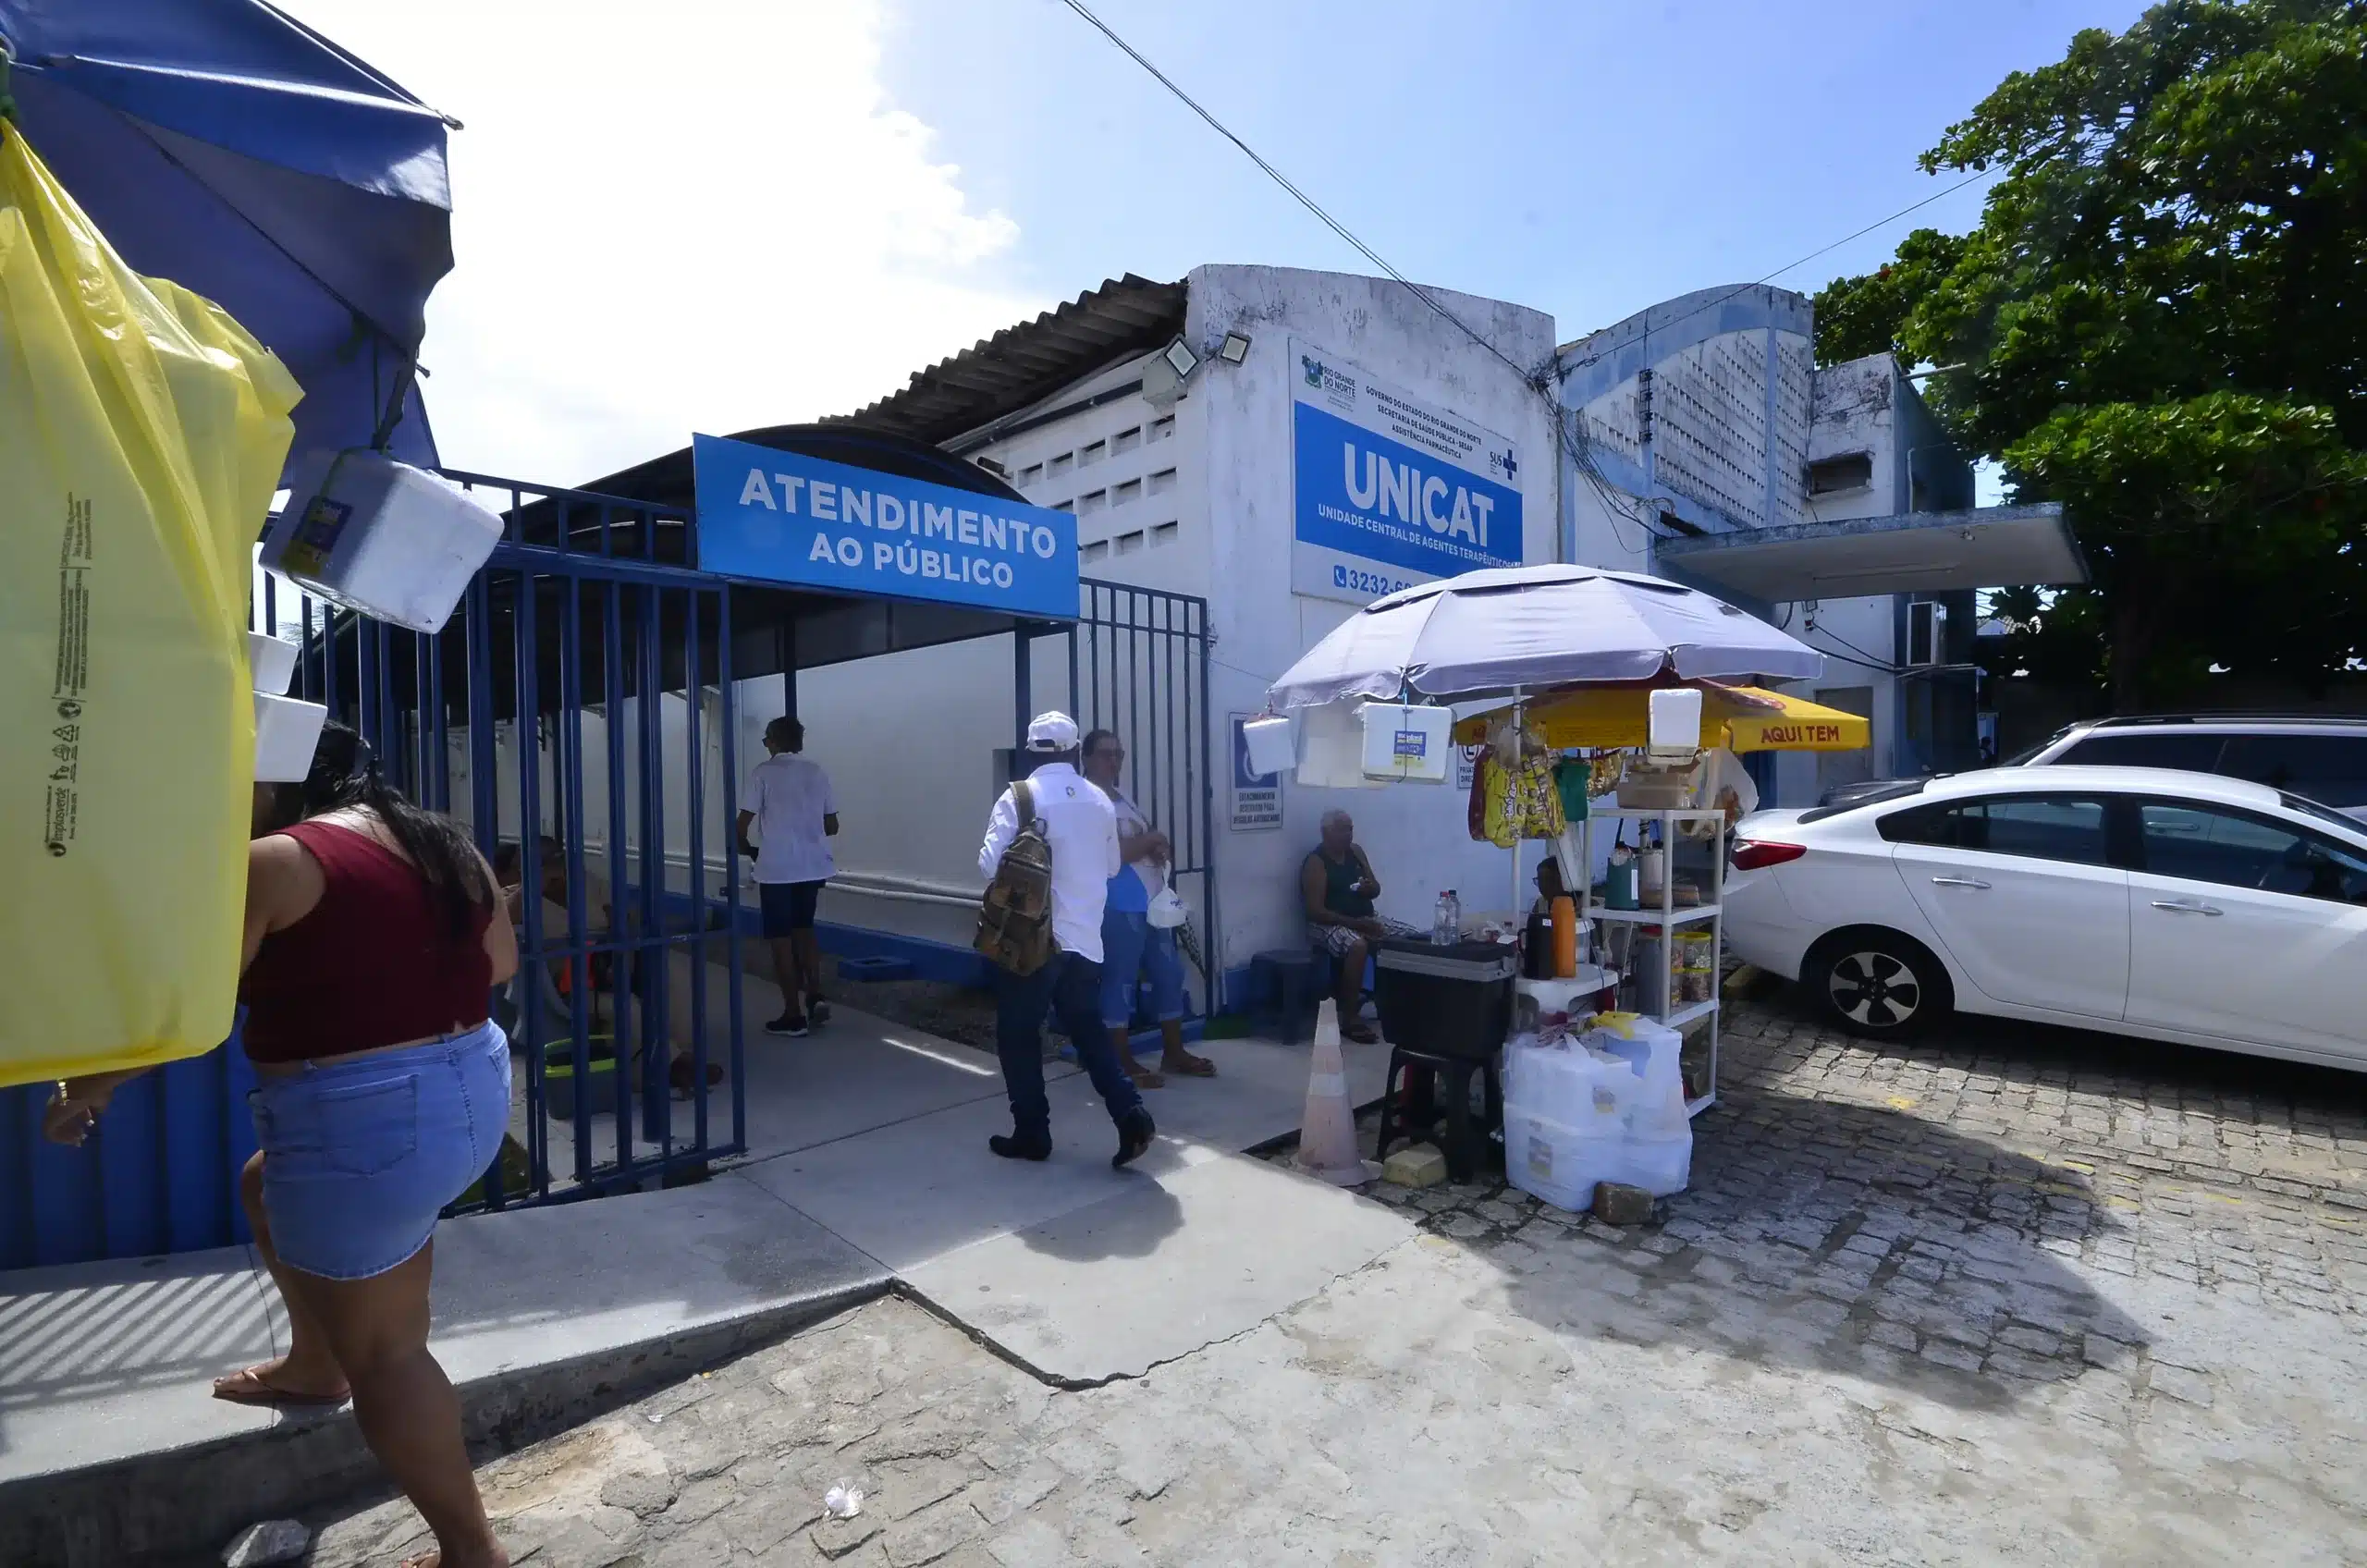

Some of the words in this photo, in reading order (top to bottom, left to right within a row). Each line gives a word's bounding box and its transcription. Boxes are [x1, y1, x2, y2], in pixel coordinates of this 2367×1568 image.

[1324, 366, 1333, 377] RIO
[1334, 371, 1355, 388] GRANDE
[1324, 375, 1333, 386] DO
[1334, 380, 1355, 398] NORTE
[1366, 386, 1392, 405] GOVERNO
[1393, 398, 1401, 408] DO
[1403, 403, 1422, 418] ESTADO
[1423, 412, 1430, 422] DO
[1430, 415, 1440, 426] RIO
[1441, 420, 1459, 435] GRANDE
[1460, 429, 1466, 439] DO
[1466, 433, 1482, 446] NORTE
[1378, 404, 1410, 425] SECRETARIA
[1411, 419, 1418, 429] DE
[1419, 422, 1435, 436] SAÚDE
[1436, 428, 1455, 445] PÚBLICA
[1458, 440, 1473, 452] SESAP
[1392, 423, 1425, 444] ASSISTÊNCIA
[1426, 438, 1462, 459] FARMACÊUTICA
[1490, 451, 1502, 466] SUS
[740, 468, 1057, 558] ATENDIMENTO
[1344, 442, 1494, 547] UNICAT
[1318, 503, 1364, 529] UNIDADE
[1366, 518, 1408, 542] CENTRAL
[1409, 532, 1421, 545] DE
[1421, 535, 1458, 557] AGENTES
[809, 533, 863, 567] AO
[874, 539, 1013, 589] PÚBLICO
[1760, 726, 1803, 743] AQUI
[1805, 725, 1840, 741] TEM
